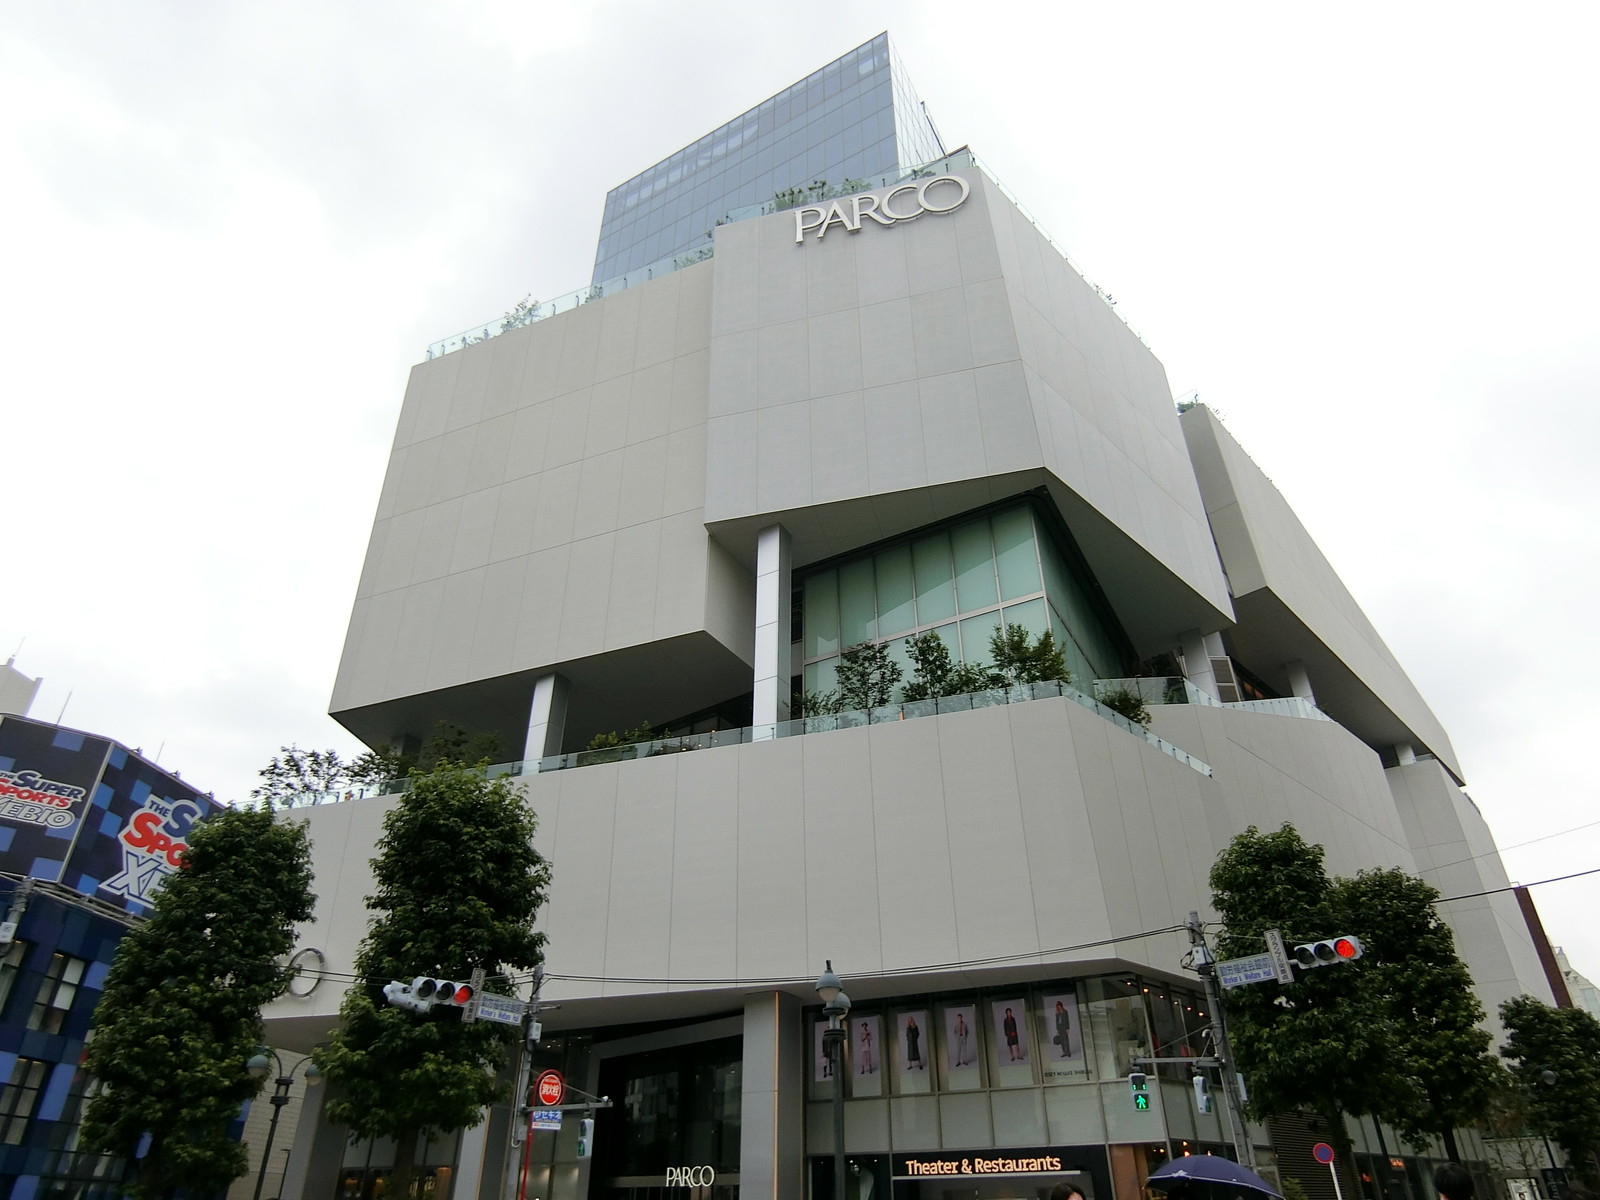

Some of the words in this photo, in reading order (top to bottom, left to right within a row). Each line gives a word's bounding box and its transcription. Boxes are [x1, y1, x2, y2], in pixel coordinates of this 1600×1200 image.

[794, 176, 970, 243] PARCO
[11, 772, 83, 799] SUPER
[149, 800, 170, 818] THE
[123, 812, 193, 869] SPO
[666, 1165, 715, 1188] PARCO
[906, 1160, 959, 1175] Theater
[961, 1158, 973, 1174] &
[974, 1156, 1061, 1173] Restaurants
